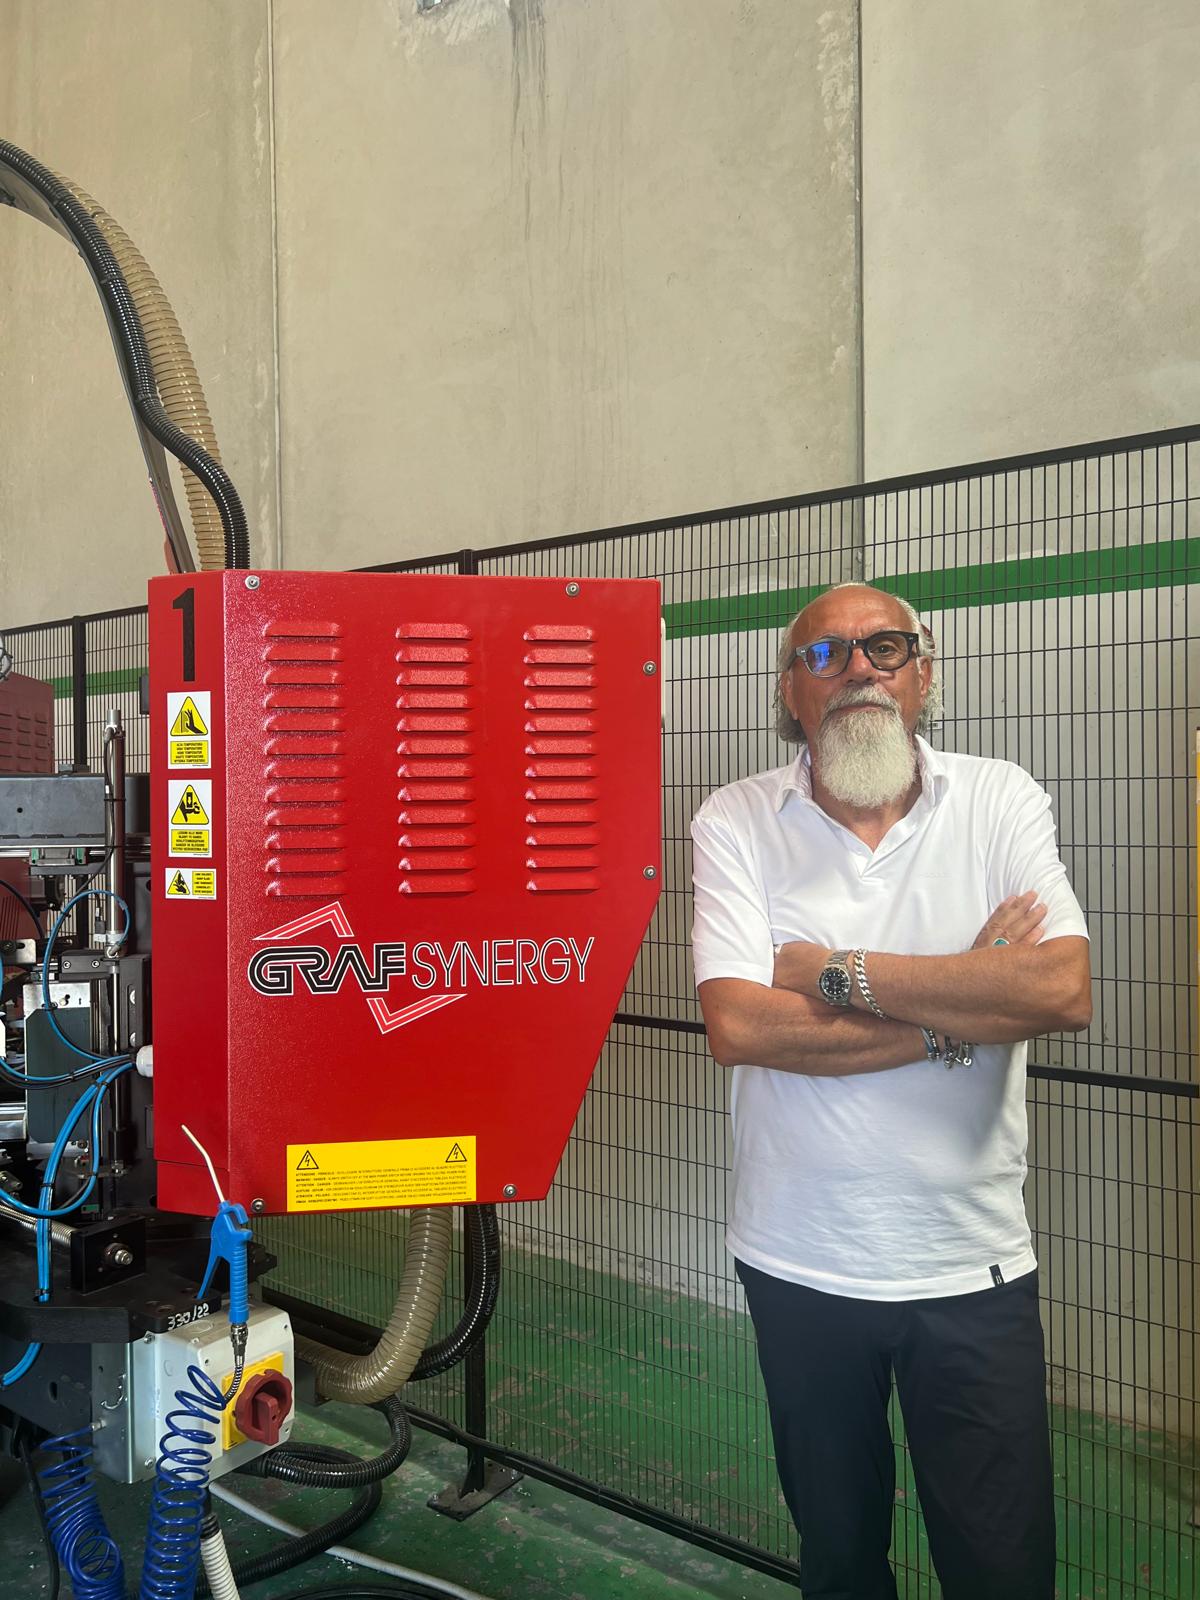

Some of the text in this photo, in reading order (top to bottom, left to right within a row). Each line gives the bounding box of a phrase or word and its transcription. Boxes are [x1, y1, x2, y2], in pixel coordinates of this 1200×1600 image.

[173, 588, 195, 681] 1
[248, 936, 595, 995] GRAF SYNERGY
